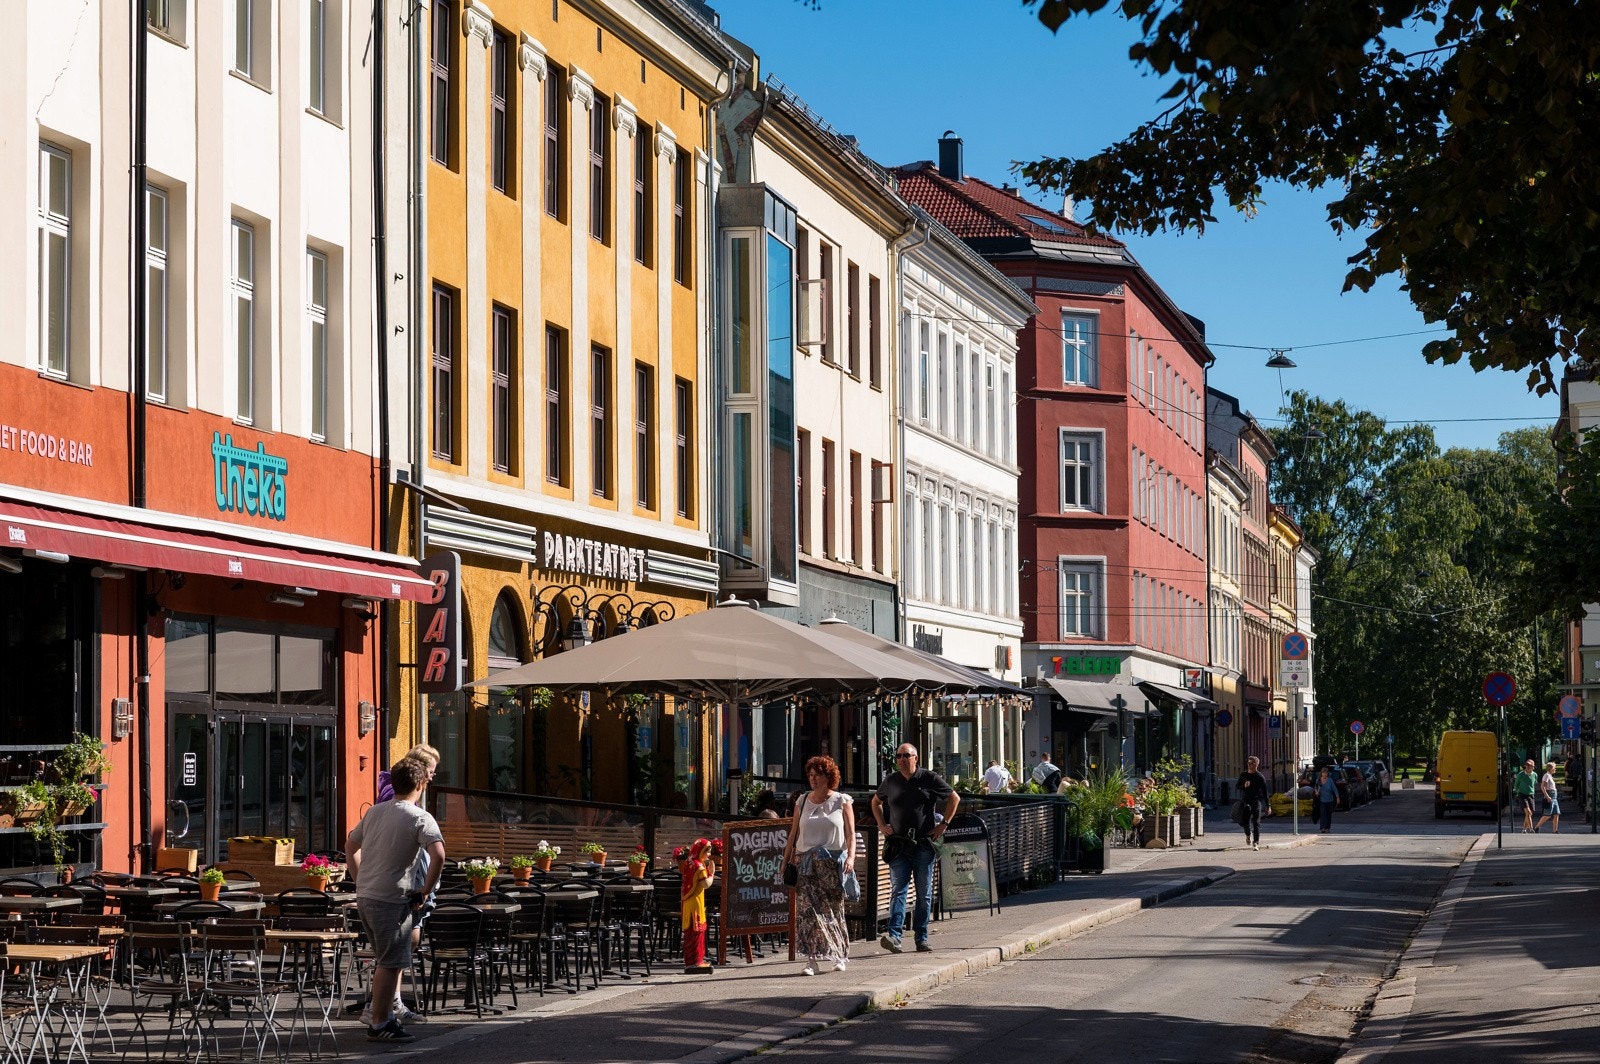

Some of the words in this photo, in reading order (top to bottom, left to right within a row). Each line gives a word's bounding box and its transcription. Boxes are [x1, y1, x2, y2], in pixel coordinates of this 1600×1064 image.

[20, 429, 57, 459] FOOD
[58, 437, 67, 462] &
[69, 439, 93, 468] BAR
[211, 431, 288, 521] theka
[543, 531, 645, 583] PARKTEATRET
[422, 569, 451, 682] BAR
[1271, 717, 1279, 727] P
[730, 829, 788, 852] DAGENS
[733, 857, 756, 883] Veg
[755, 855, 785, 880] thali
[738, 887, 771, 901] THALI
[758, 911, 790, 925] theka
